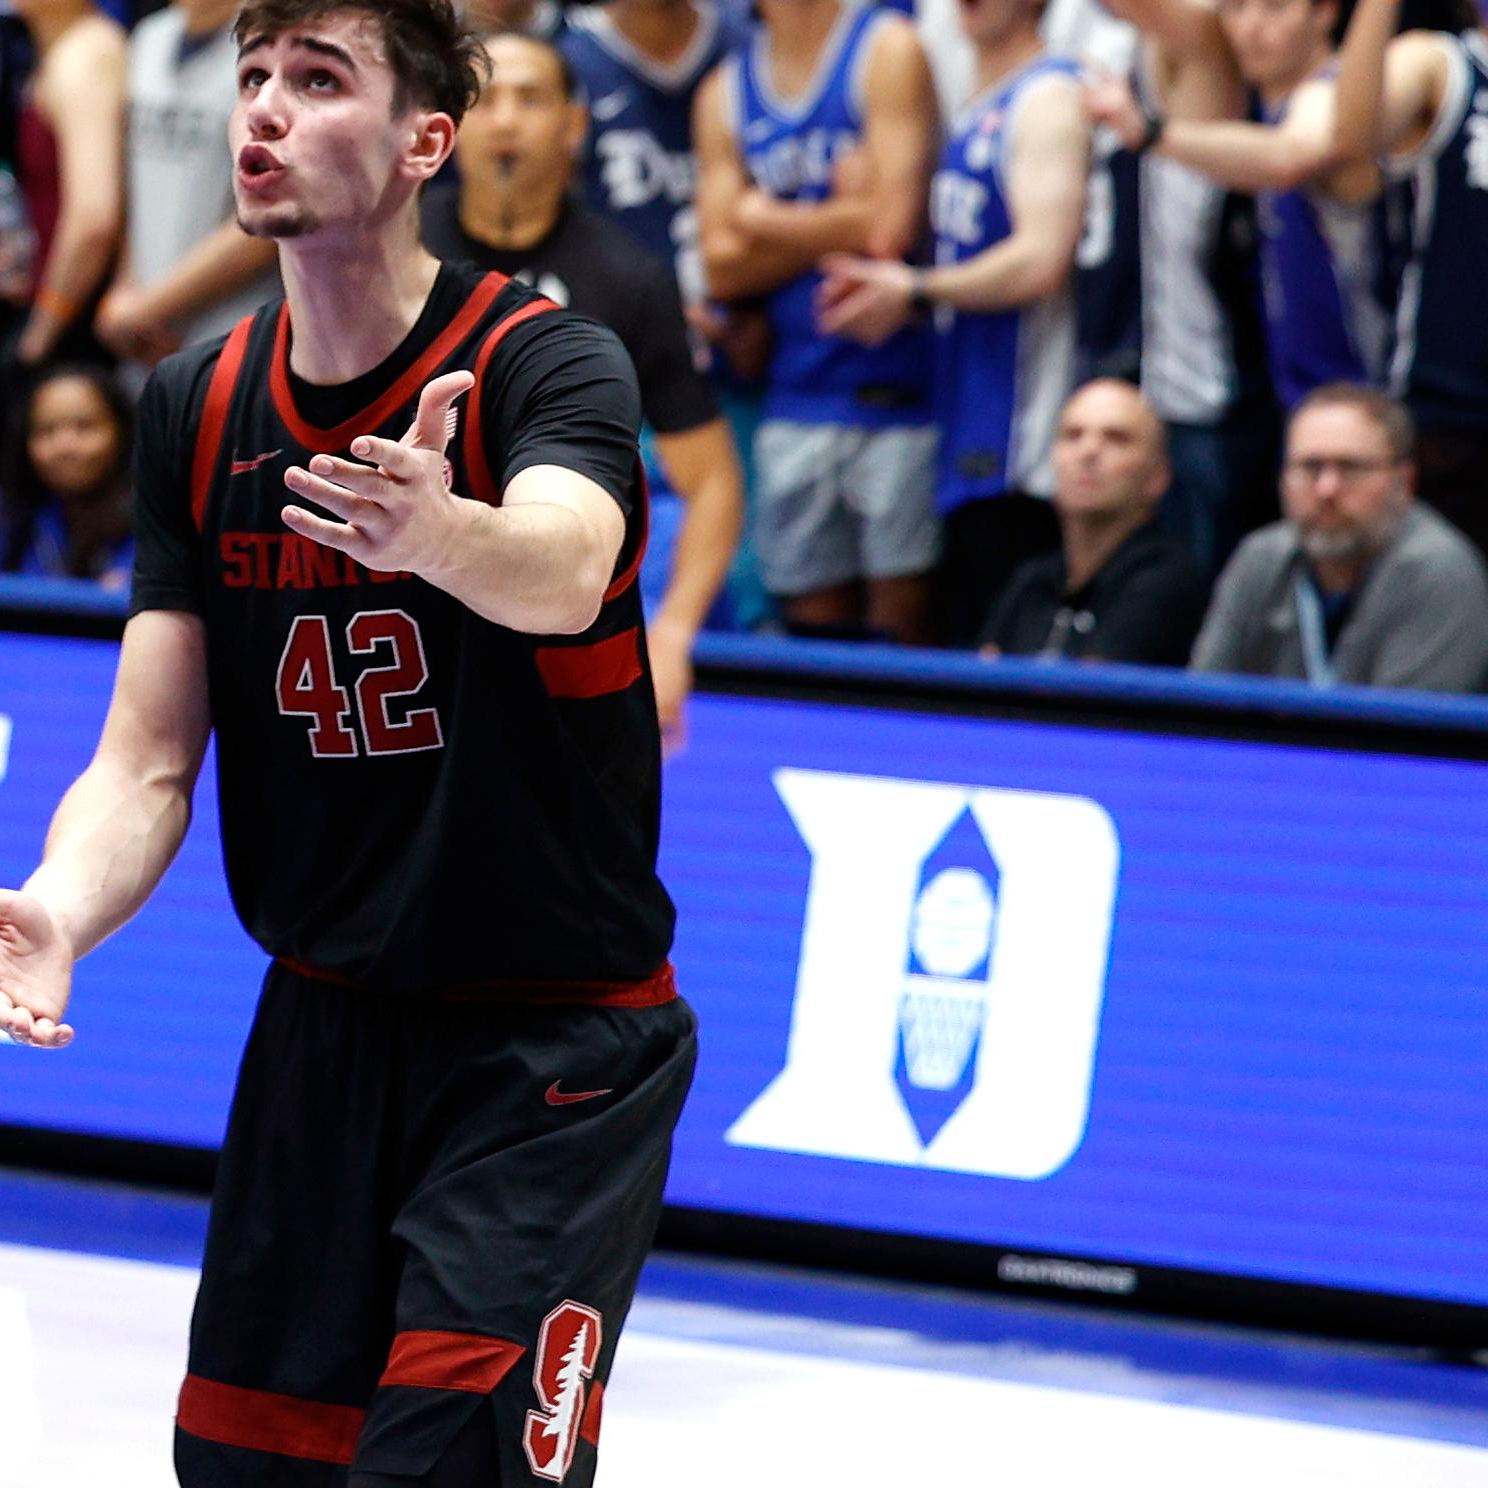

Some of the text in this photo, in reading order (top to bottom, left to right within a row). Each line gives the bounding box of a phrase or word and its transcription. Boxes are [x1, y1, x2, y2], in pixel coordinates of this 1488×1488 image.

[219, 531, 415, 590] STAN
[275, 609, 445, 758] 42
[724, 766, 1123, 1183] D
